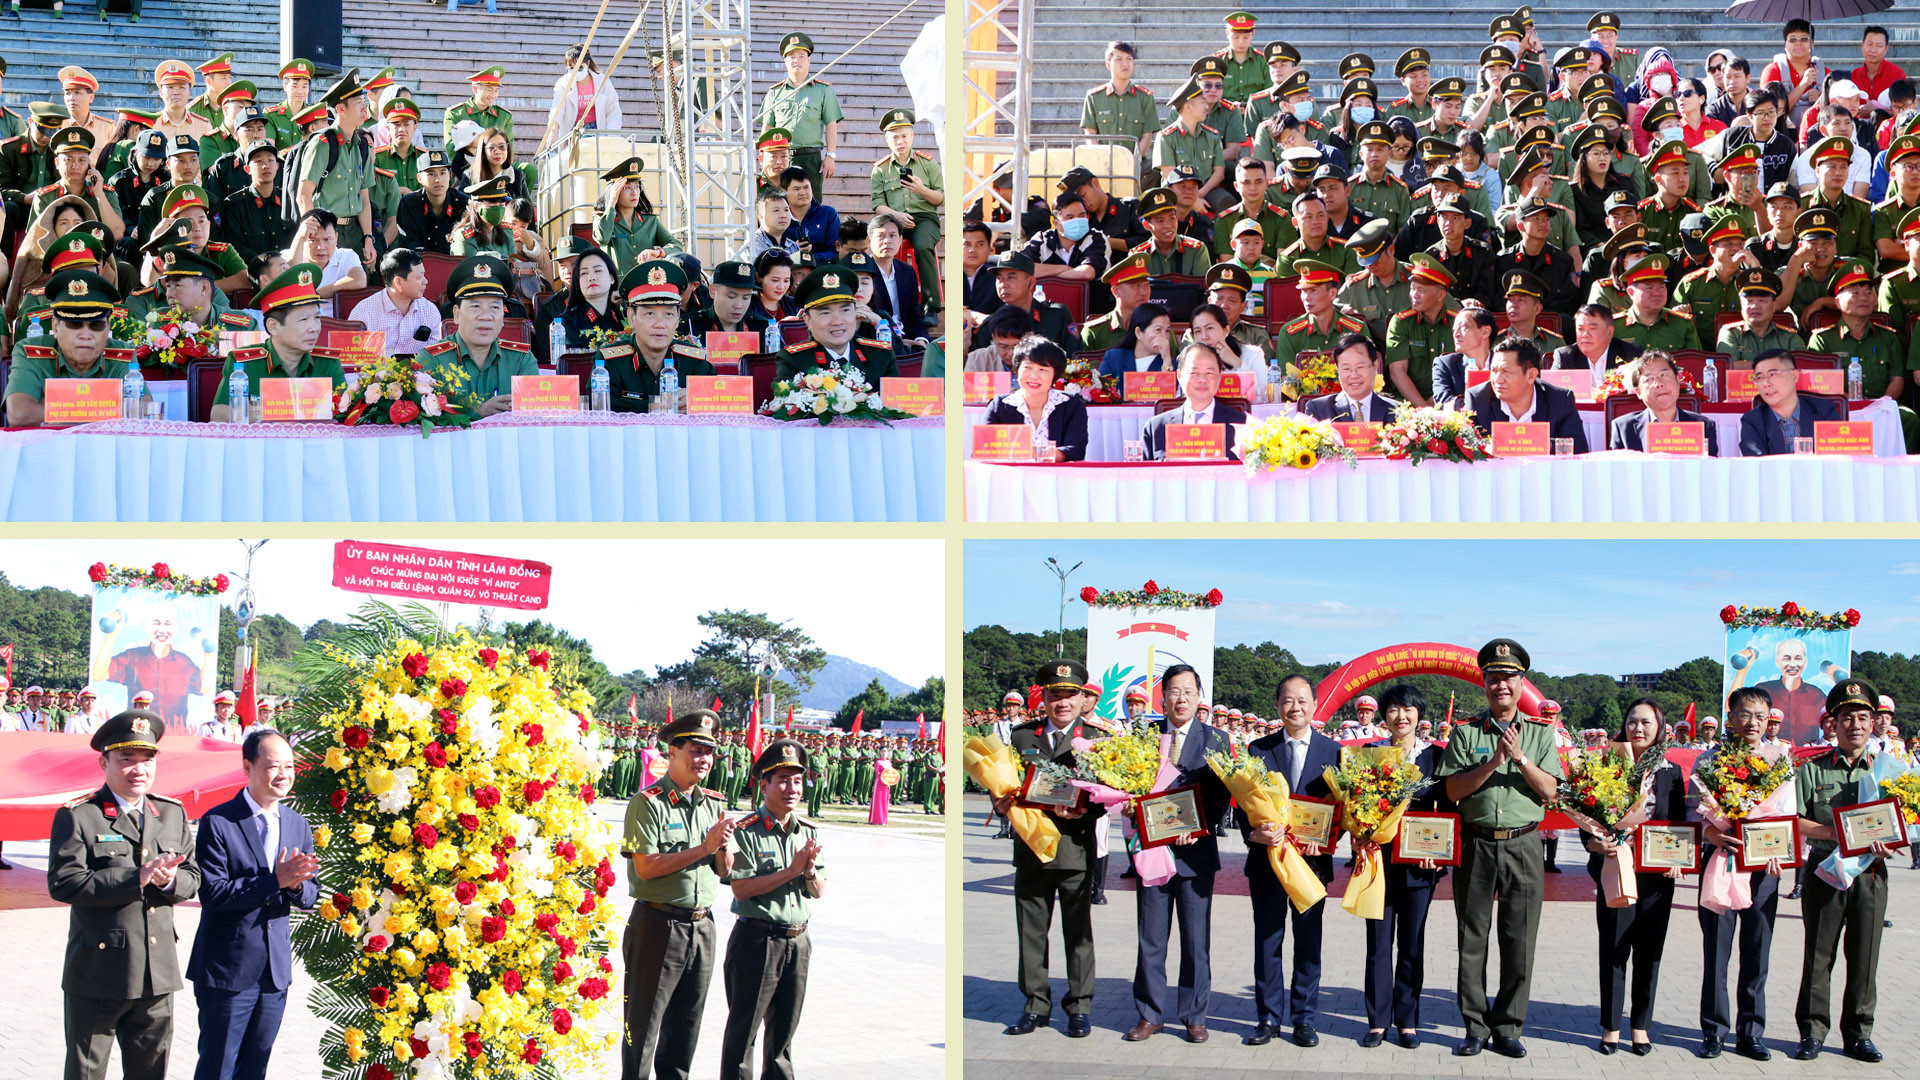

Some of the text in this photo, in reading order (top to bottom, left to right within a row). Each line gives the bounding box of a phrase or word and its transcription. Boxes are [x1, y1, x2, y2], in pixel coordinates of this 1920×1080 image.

[346, 545, 541, 578] ỦY BAN NHÂN DÂN TỈNH LÂM ĐỒNG
[370, 565, 394, 576] CHÚC
[396, 568, 422, 579] MỪNG
[424, 572, 439, 582] ĐẠI
[440, 573, 455, 583] HỘI
[457, 574, 479, 586] KHỎE
[344, 576, 542, 605] VÀ HỘI THI ĐIỀU LỆNH, QUÂN SỰ, VÕ THUẬT CAND
